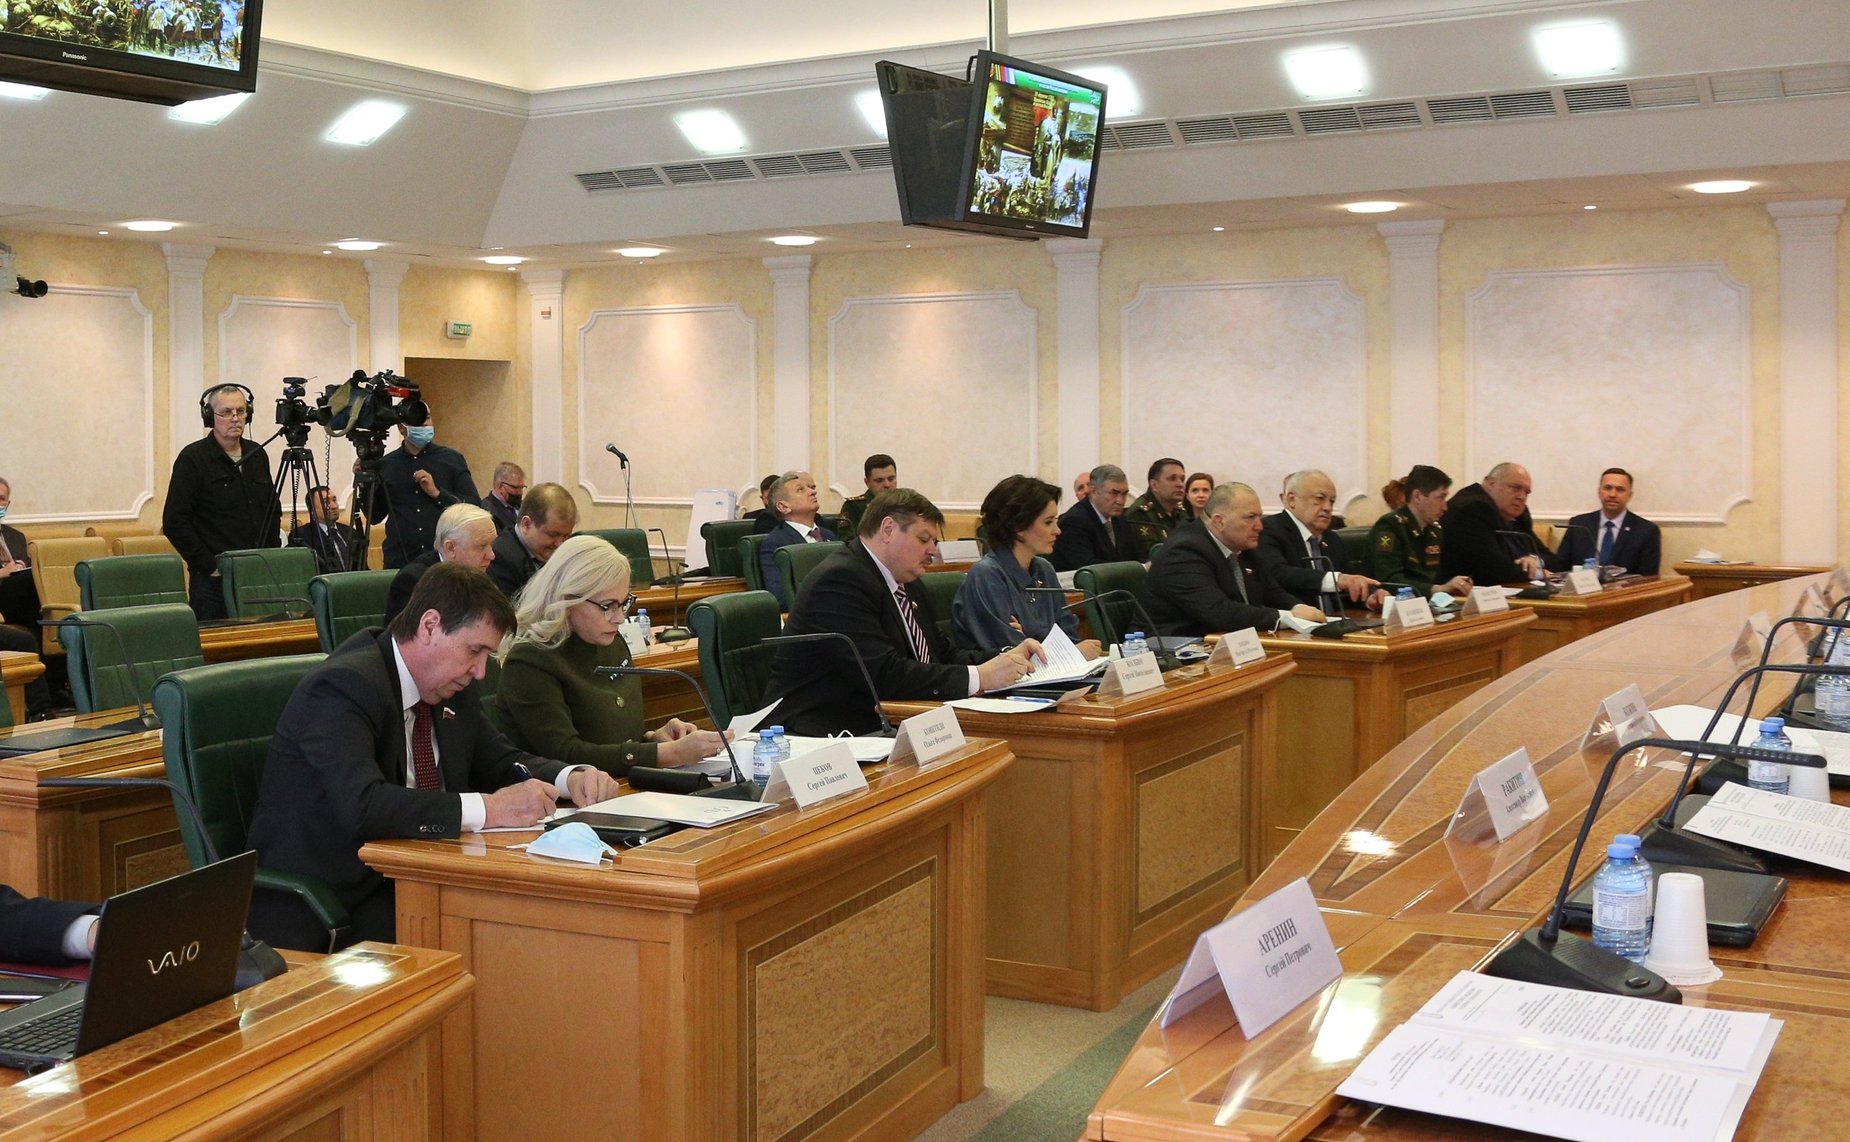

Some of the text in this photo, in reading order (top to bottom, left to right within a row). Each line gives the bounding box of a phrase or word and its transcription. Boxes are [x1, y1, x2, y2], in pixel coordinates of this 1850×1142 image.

[62, 51, 87, 60] Panasonic
[807, 772, 849, 791] Сергей Павлович
[812, 762, 833, 775] ЦЕКОВ
[1257, 917, 1298, 956] АРЕНИН
[147, 940, 199, 975] VAIO
[1264, 942, 1312, 978] Сергей Петрович
